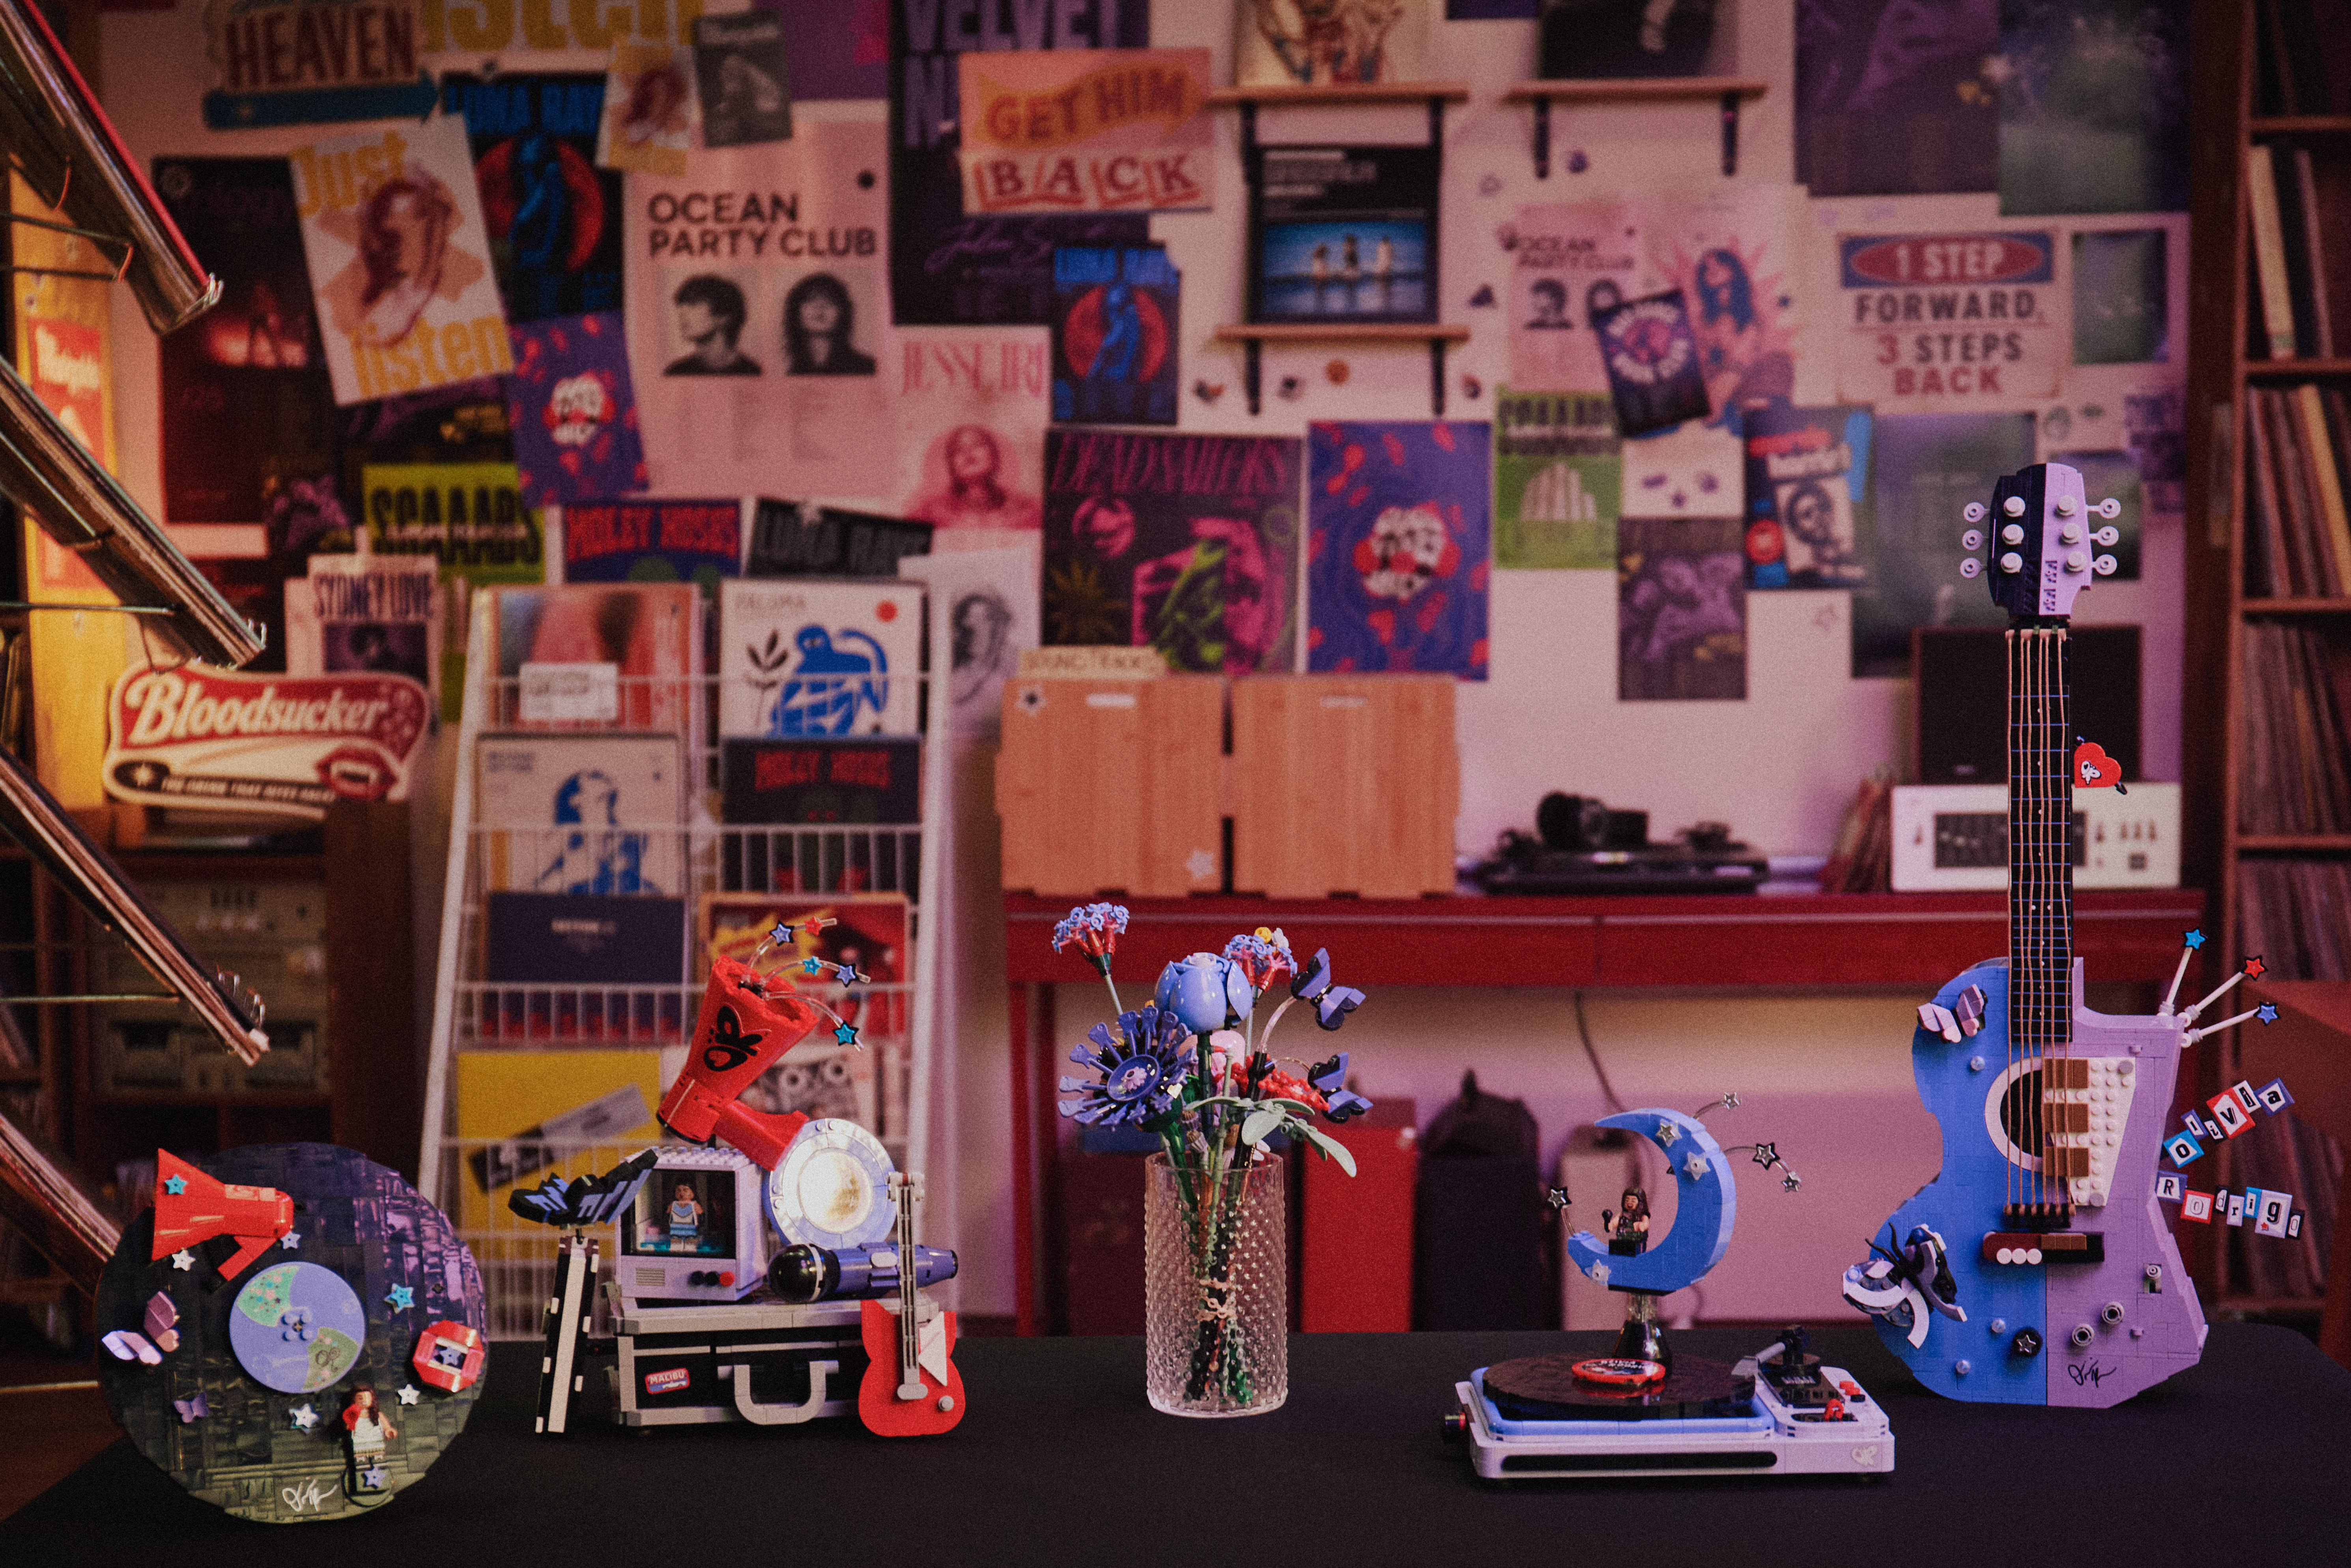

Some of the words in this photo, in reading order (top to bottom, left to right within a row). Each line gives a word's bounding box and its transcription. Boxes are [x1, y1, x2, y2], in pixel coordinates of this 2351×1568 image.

[226, 6, 414, 85] HEAVEN
[985, 85, 1084, 141] GET
[1095, 68, 1185, 123] HIM
[288, 131, 409, 219] Just
[988, 156, 1195, 196] BACK
[647, 192, 798, 224] OCEAN
[648, 228, 774, 258] PARTY
[779, 228, 876, 257] CLUB
[1897, 242, 1910, 278] 1
[1922, 239, 2005, 278] STEP
[348, 314, 514, 398] listen
[1876, 334, 1900, 365] 3
[1916, 331, 2024, 364] STEPS
[1893, 367, 2004, 396] BACK
[125, 673, 389, 745] Bloodsucker
[649, 1369, 685, 1385] MALIBU
